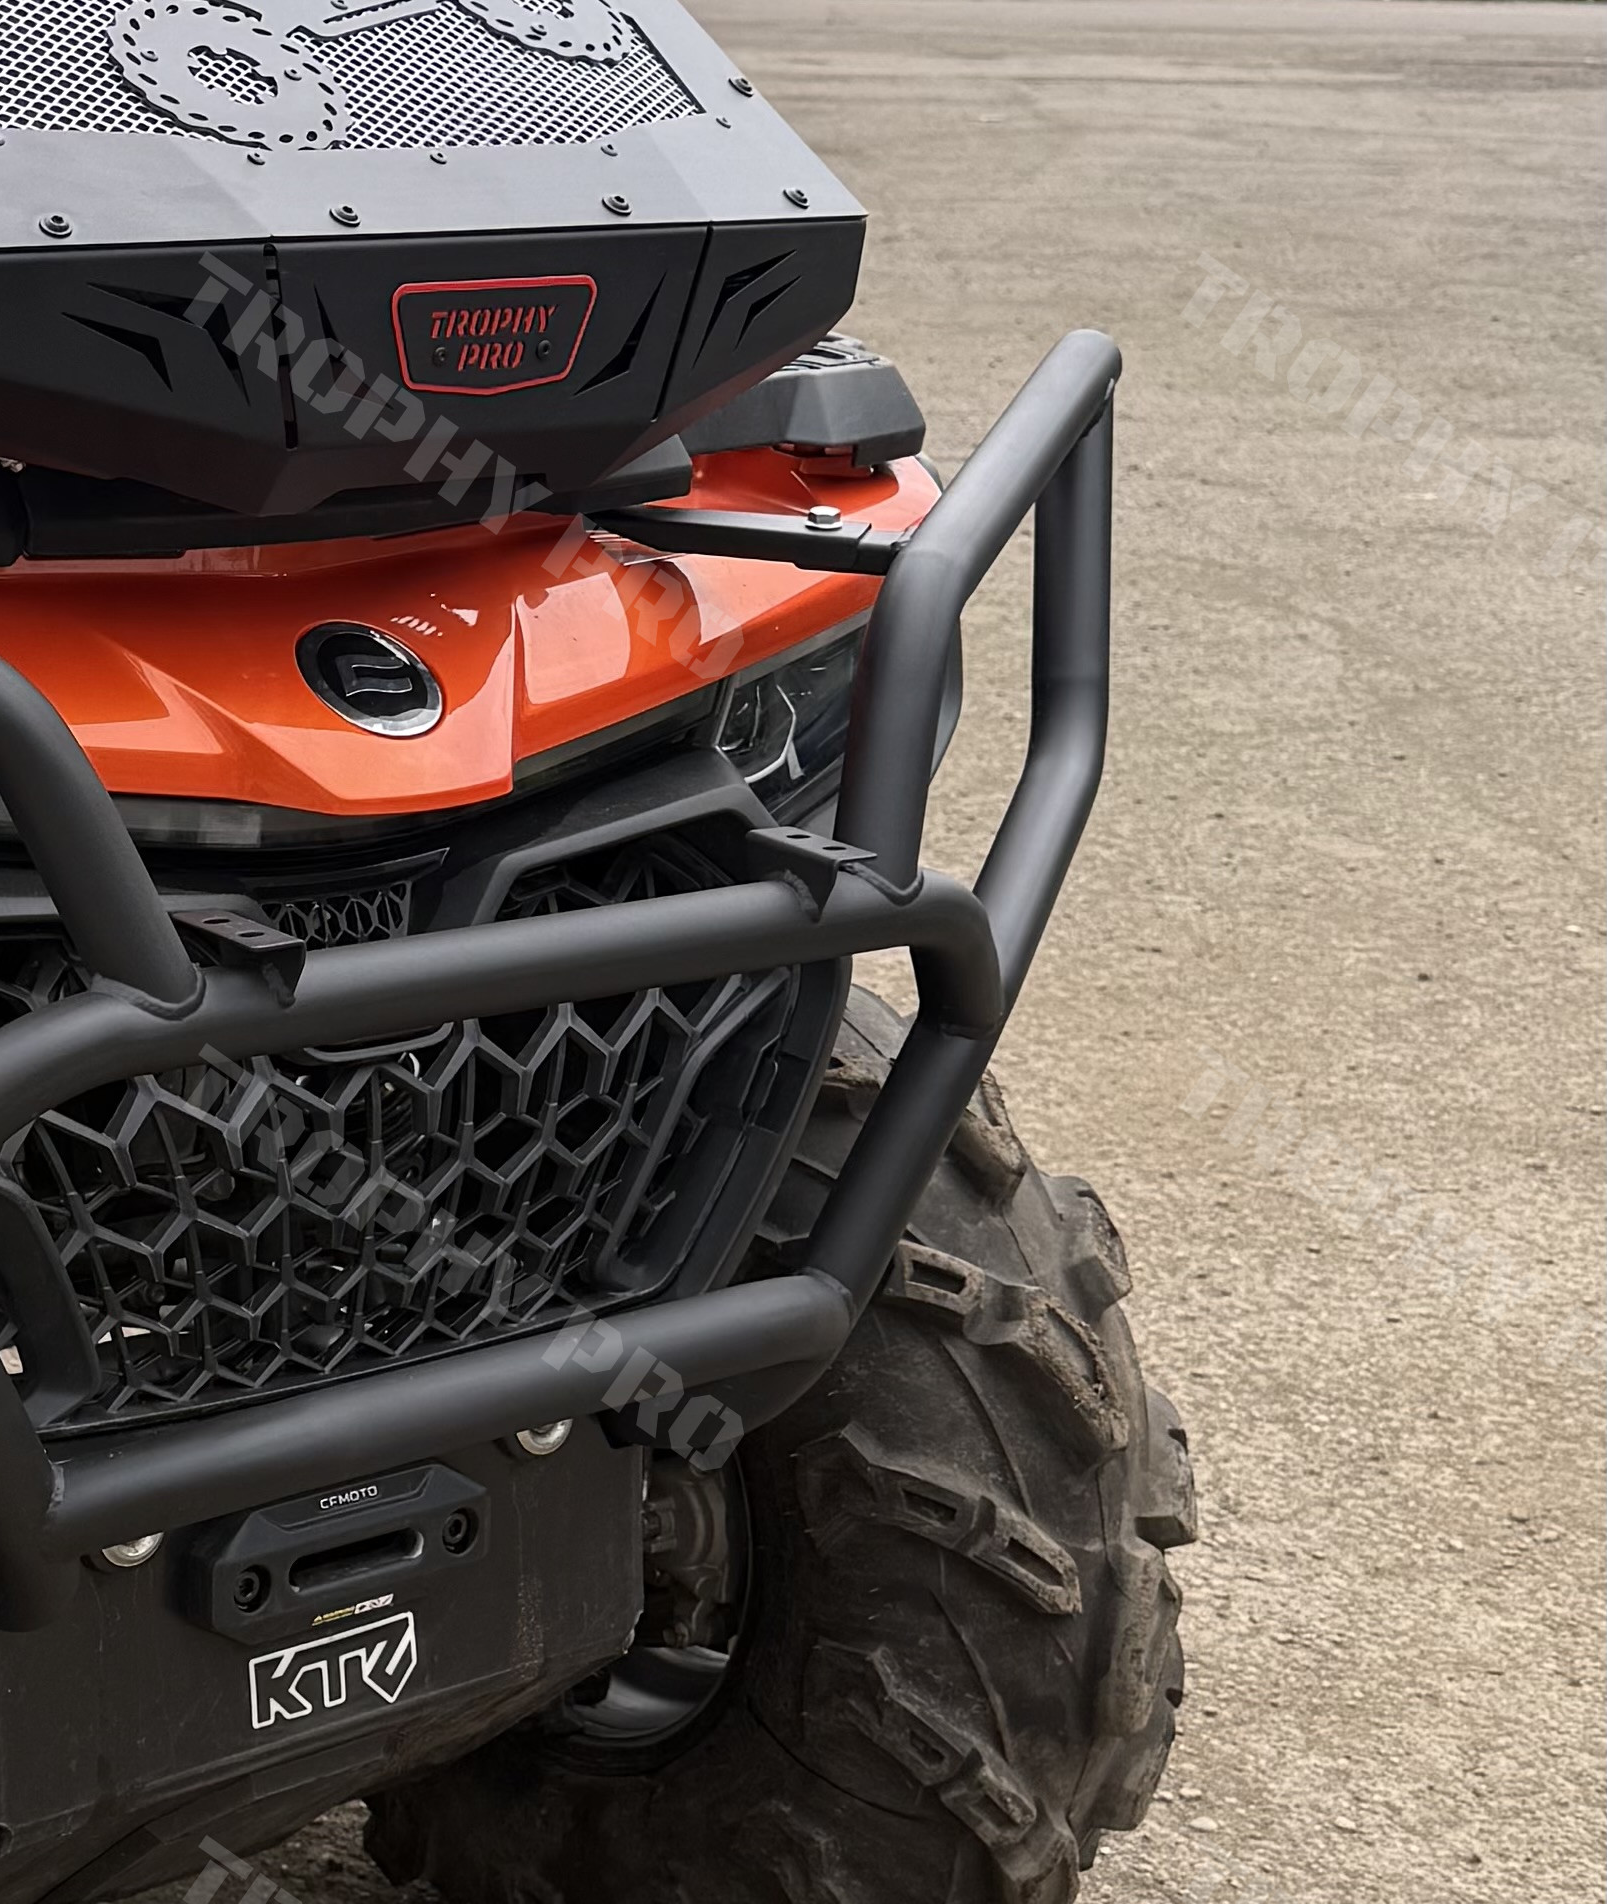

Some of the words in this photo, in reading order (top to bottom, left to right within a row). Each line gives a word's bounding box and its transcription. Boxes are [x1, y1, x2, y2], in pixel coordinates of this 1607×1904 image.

[430, 304, 559, 339] TROPHY
[457, 341, 526, 372] PRO
[319, 1484, 379, 1510] CFMOTO
